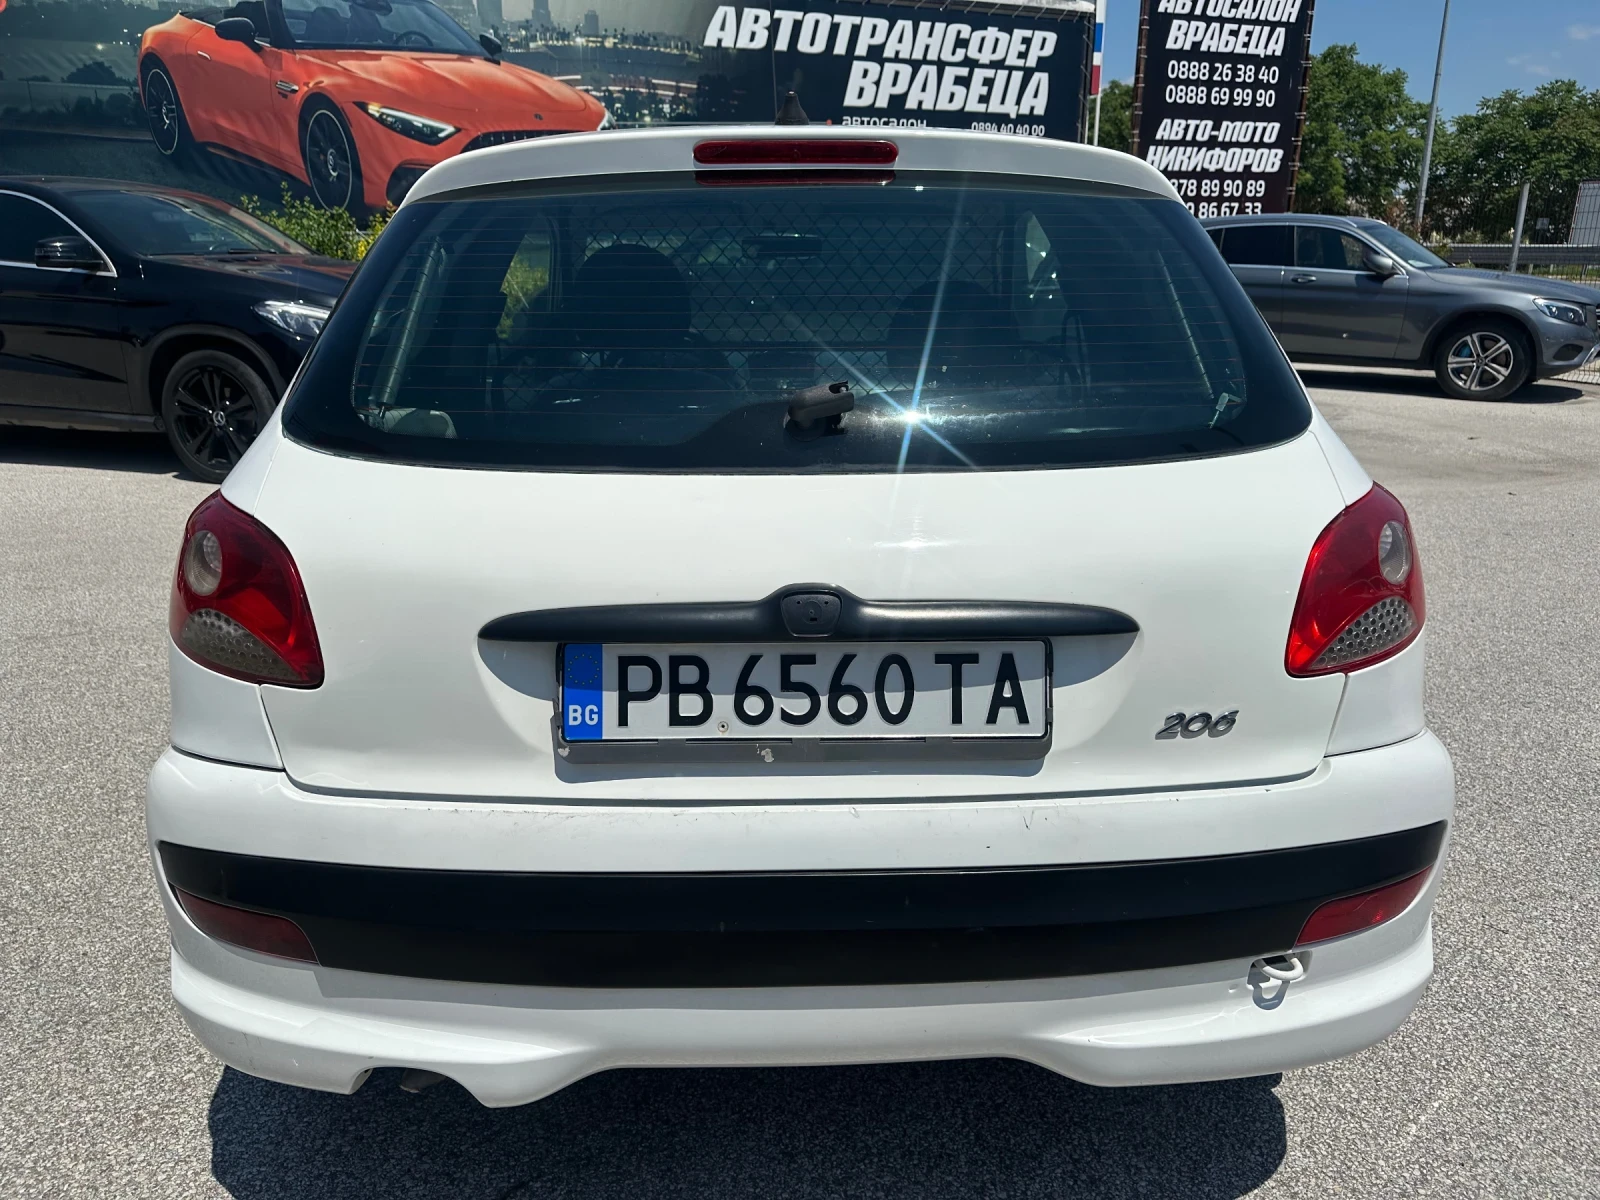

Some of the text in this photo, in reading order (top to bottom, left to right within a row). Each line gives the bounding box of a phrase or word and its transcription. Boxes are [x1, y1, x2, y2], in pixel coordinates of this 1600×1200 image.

[703, 5, 1058, 68] АВТОТРАНСФЕР
[1165, 19, 1286, 58] ВРАБЕЦА
[1167, 60, 1279, 84] 0888 26 38 40
[842, 60, 1050, 119] ВРАБЕЦА
[1165, 84, 1276, 107] 0888 69 99 90
[1000, 122, 1014, 134] 40
[1016, 123, 1030, 136] 40
[1031, 124, 1045, 137] 00
[1146, 145, 1284, 173] НИКИФОРОВ
[1200, 179, 1220, 197] 89
[1223, 179, 1242, 198] 90
[1246, 180, 1266, 198] 89
[1198, 202, 1218, 219] 86
[1221, 202, 1239, 218] 67
[617, 652, 1030, 728] PB 6560 TA
[568, 704, 599, 727] BG
[1154, 709, 1240, 741] 206
